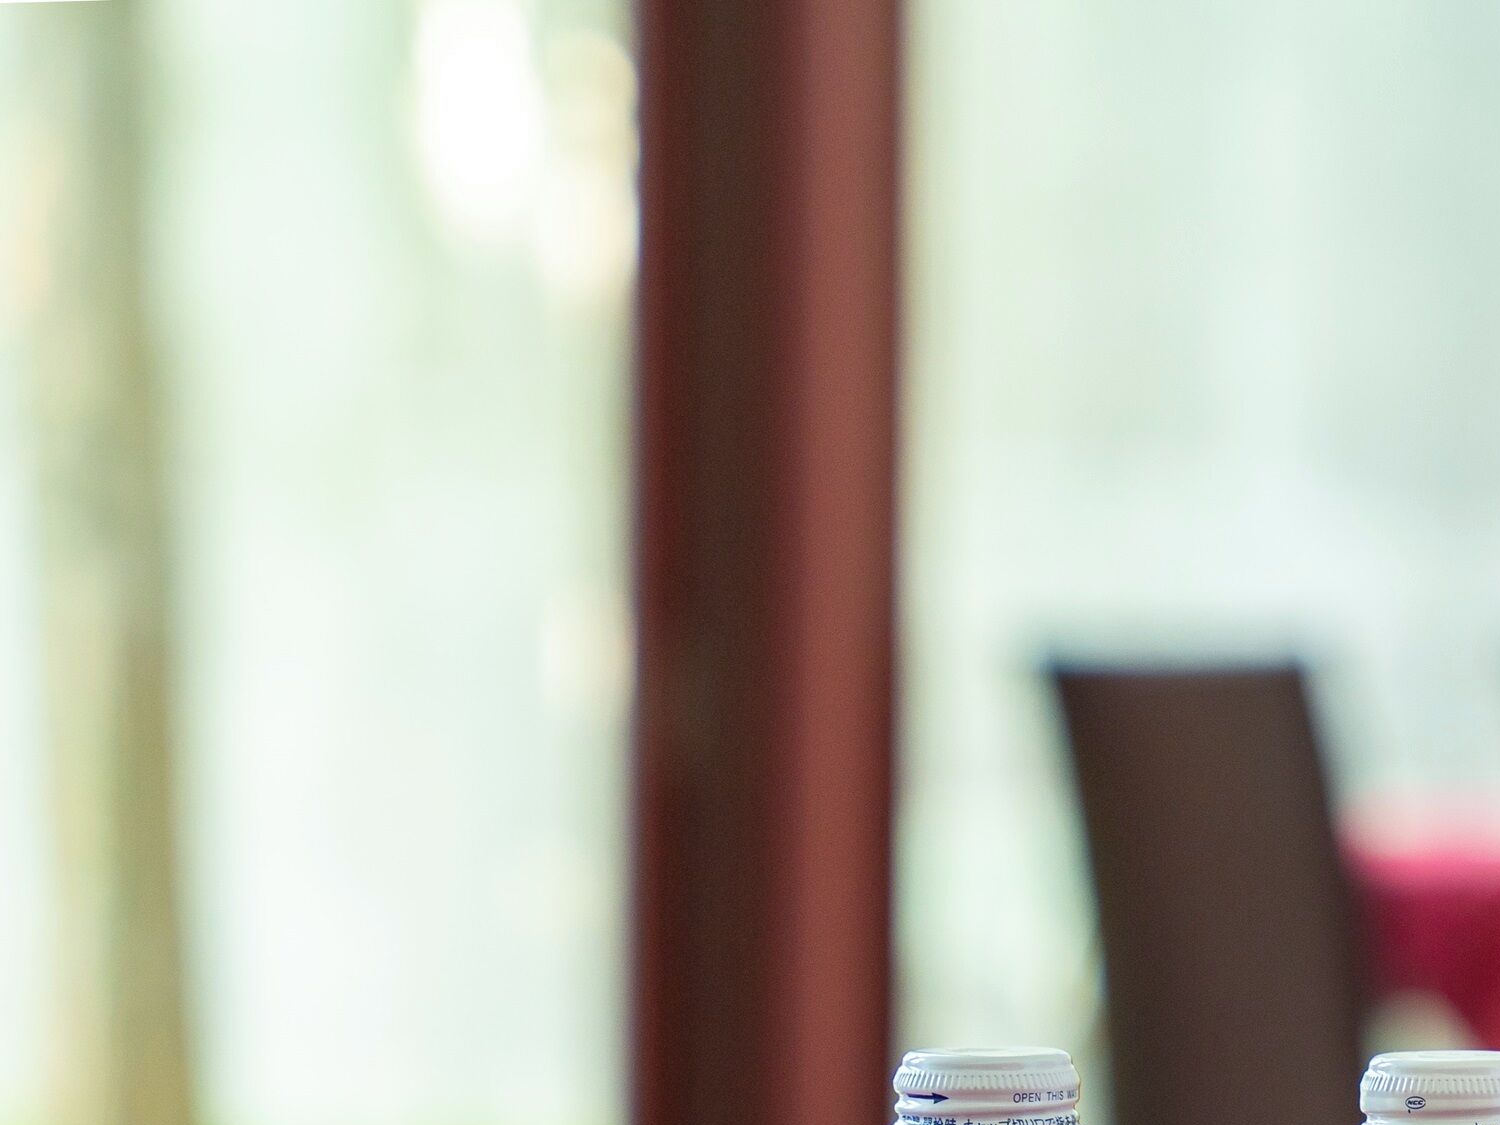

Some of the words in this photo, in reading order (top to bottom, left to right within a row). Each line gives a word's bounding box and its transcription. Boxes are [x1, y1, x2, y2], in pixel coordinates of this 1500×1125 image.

[1013, 1092, 1041, 1103] OPEN
[1047, 1090, 1064, 1101] THIS
[1067, 1090, 1077, 1099] WA
